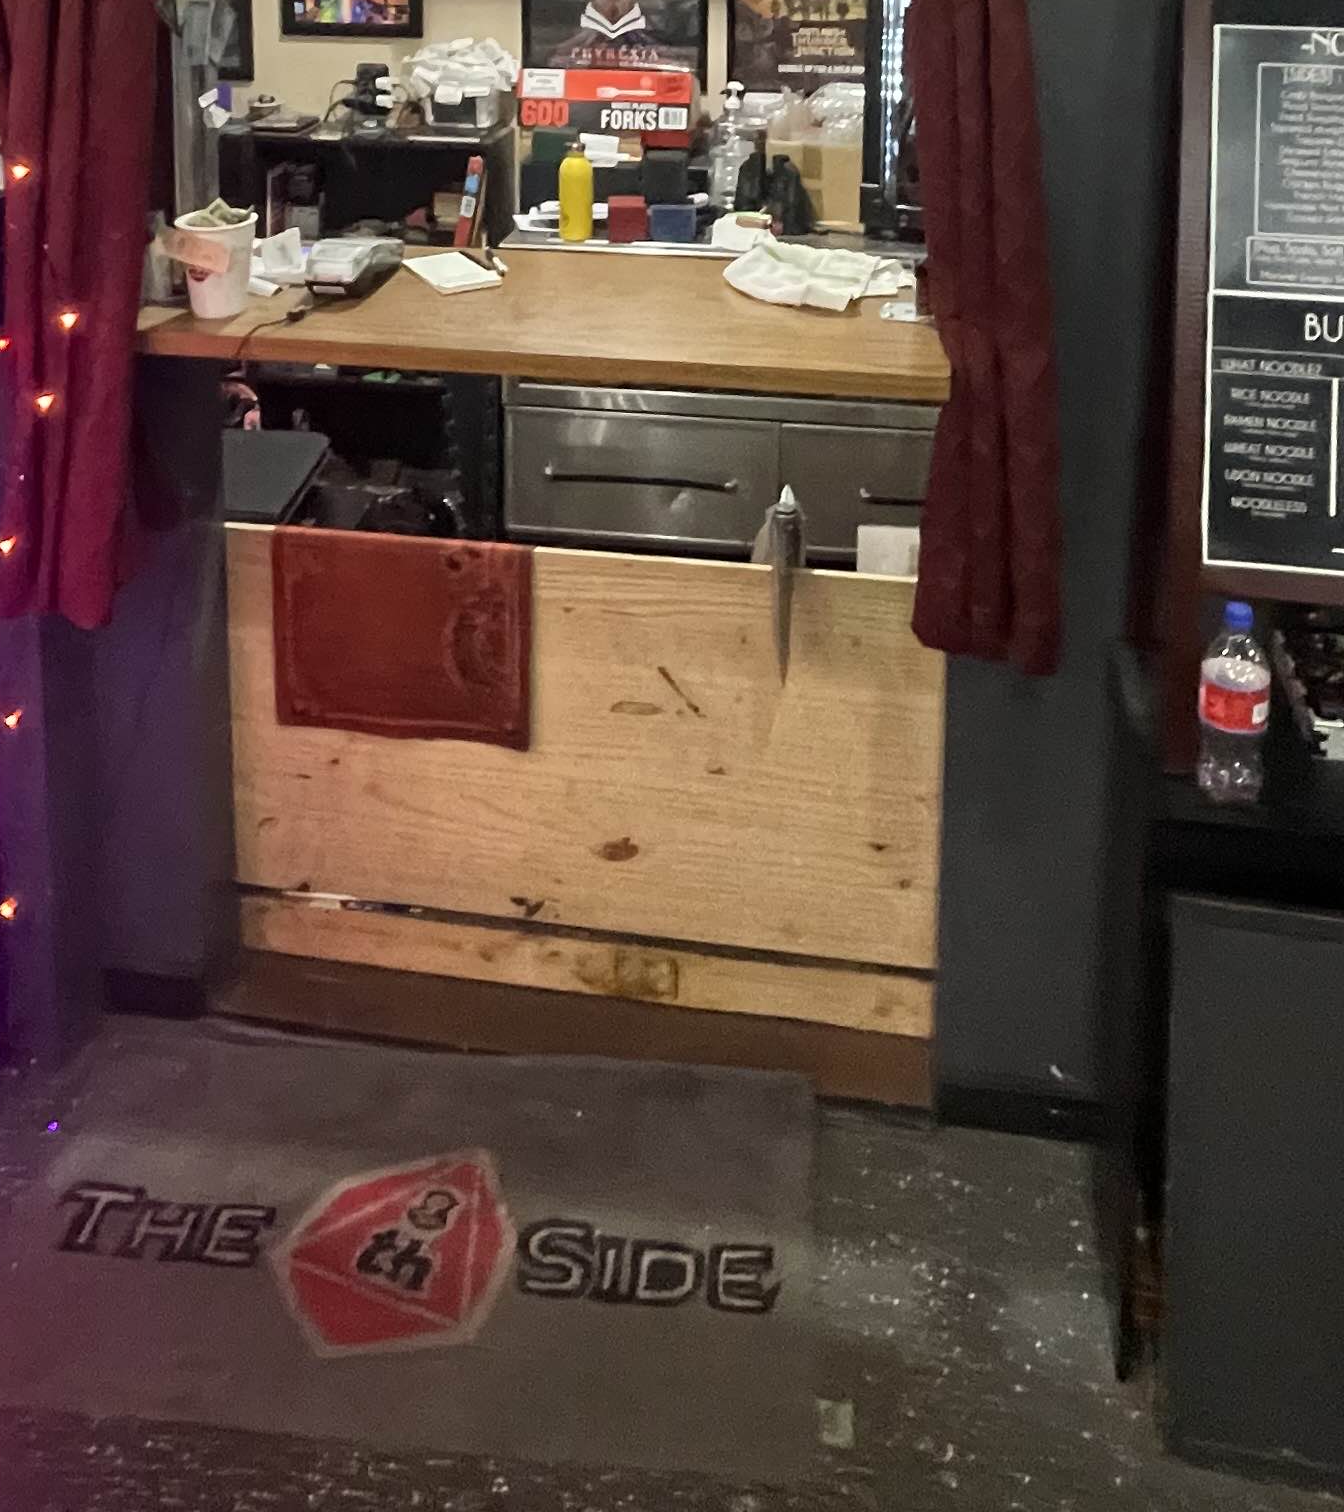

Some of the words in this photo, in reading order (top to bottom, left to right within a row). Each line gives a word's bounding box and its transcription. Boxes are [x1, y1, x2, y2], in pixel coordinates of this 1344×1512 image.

[521, 100, 570, 128] 600
[600, 109, 657, 131] FORKS
[56, 1181, 276, 1267] THE
[518, 1219, 780, 1313] SIDE
